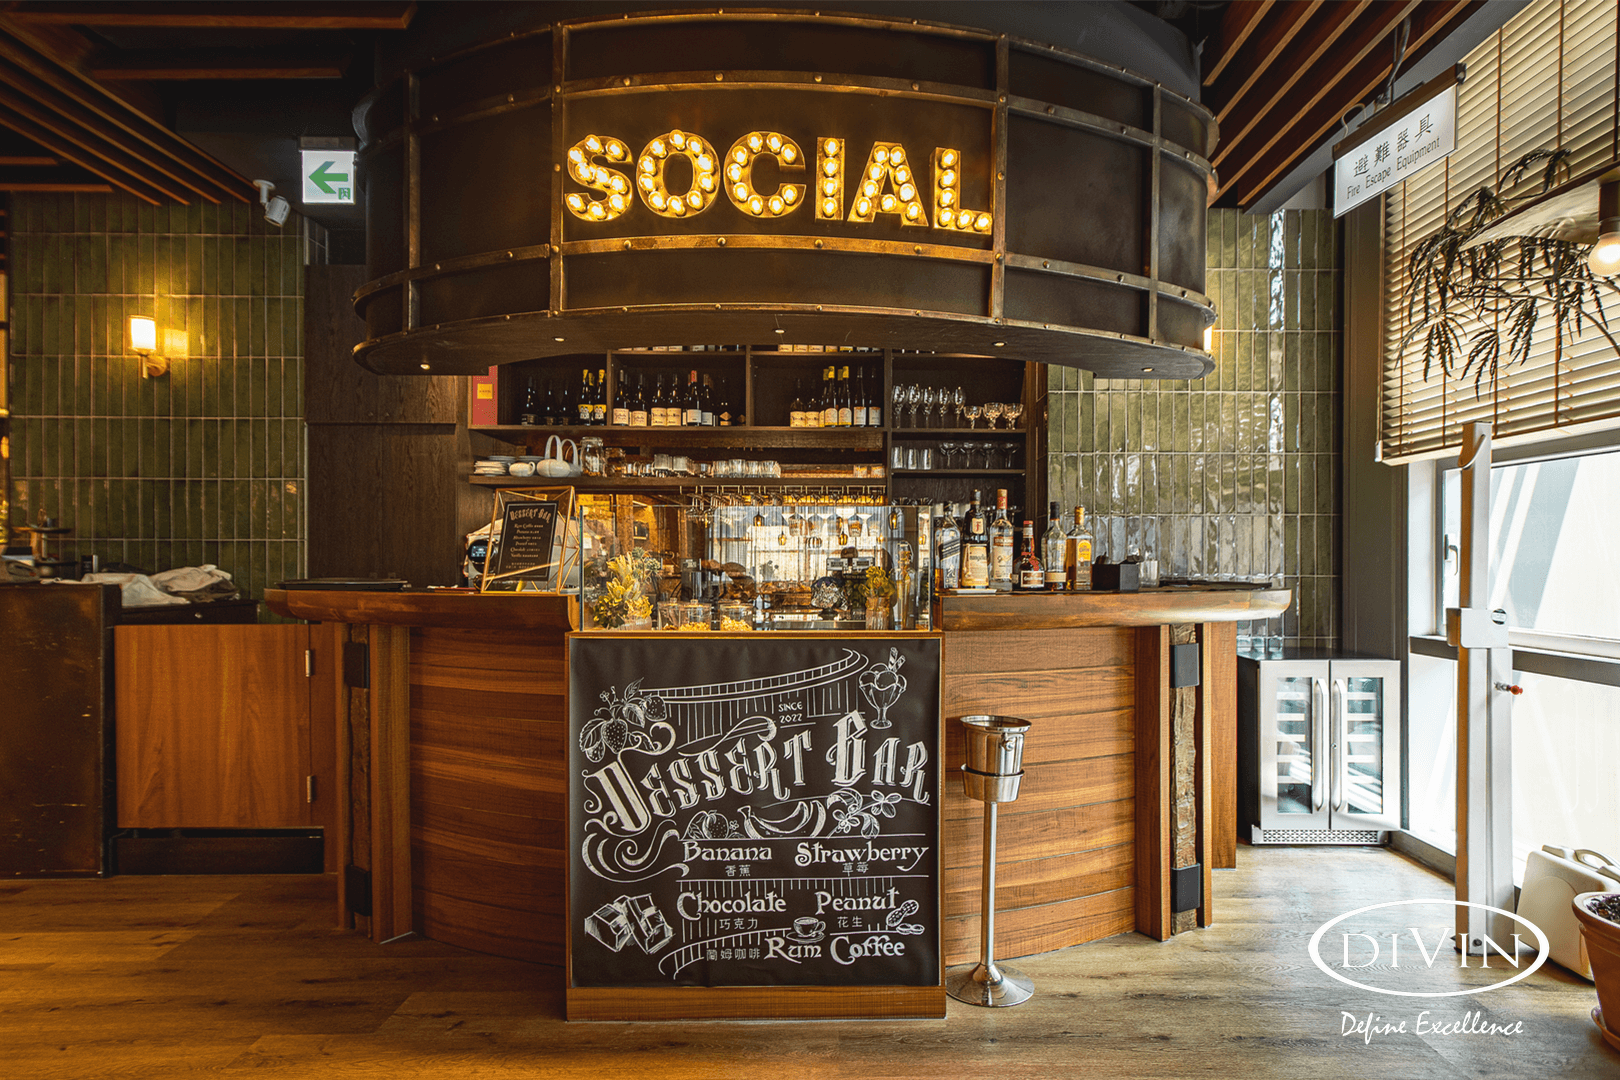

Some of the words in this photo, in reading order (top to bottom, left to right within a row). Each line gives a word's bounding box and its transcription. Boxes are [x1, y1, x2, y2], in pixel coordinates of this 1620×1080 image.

[1353, 113, 1434, 177] 避難器具
[1346, 184, 1360, 199] Fire
[1365, 167, 1391, 189] Escape
[1396, 136, 1440, 171] Equipment
[565, 129, 993, 236] SOCIAL
[778, 701, 803, 713] SINCE
[779, 713, 803, 723] 2022
[682, 840, 772, 863] Banana
[794, 840, 929, 871] Strawberry
[725, 864, 751, 877] 香蕉
[842, 862, 869, 877] 草莓
[676, 891, 787, 920] Chocolate
[814, 887, 900, 915] Peanut
[719, 917, 758, 930] 巧克力
[837, 916, 863, 928] 花生
[763, 937, 822, 964] Rum
[829, 935, 905, 965] Coffee
